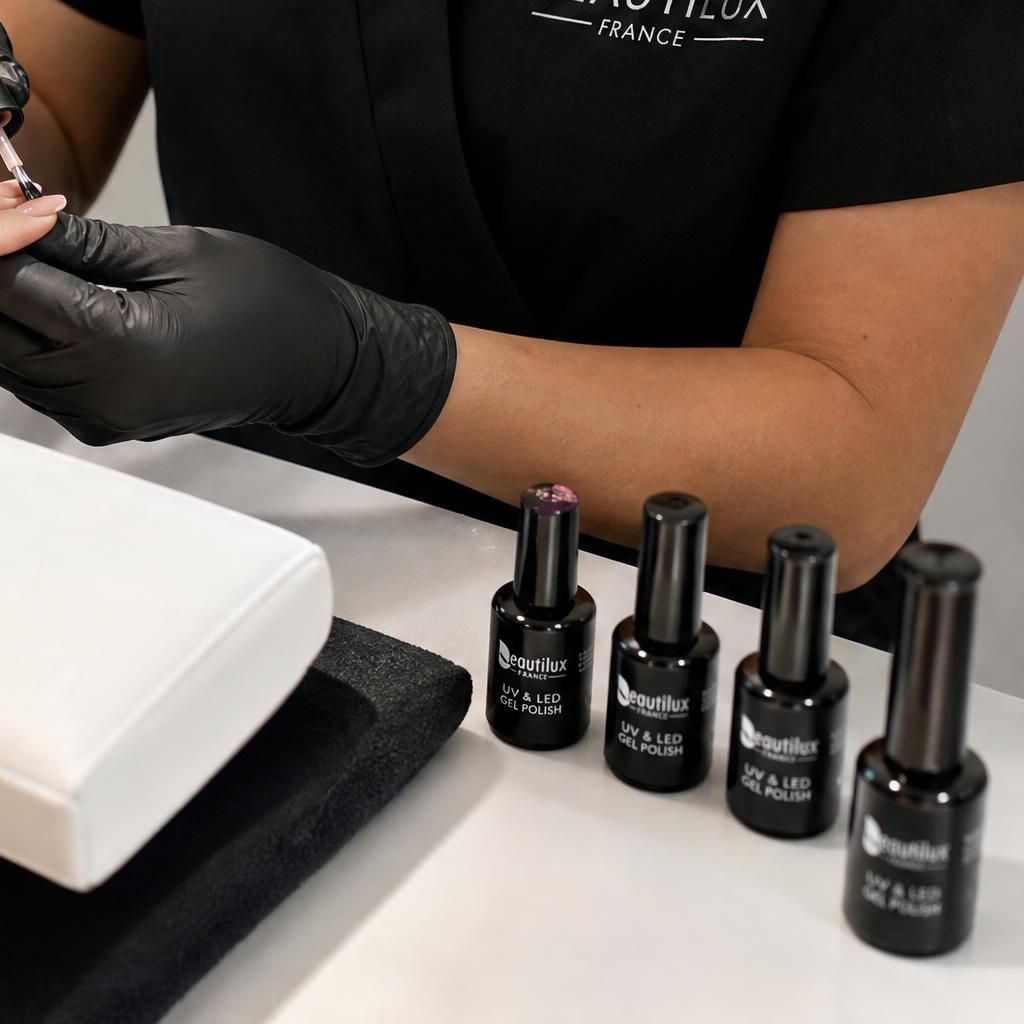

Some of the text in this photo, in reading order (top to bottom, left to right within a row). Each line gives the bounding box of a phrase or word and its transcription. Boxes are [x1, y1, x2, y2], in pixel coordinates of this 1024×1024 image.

[597, 19, 686, 47] FRANCE
[517, 670, 548, 681] FRANCE
[500, 694, 562, 716] GEL POLISH
[502, 683, 561, 704] UV & LED
[618, 732, 684, 757] GEL POLISH
[621, 720, 683, 745] UV & LED
[744, 762, 812, 789] UV & LED
[741, 775, 812, 803] GEL POLISH
